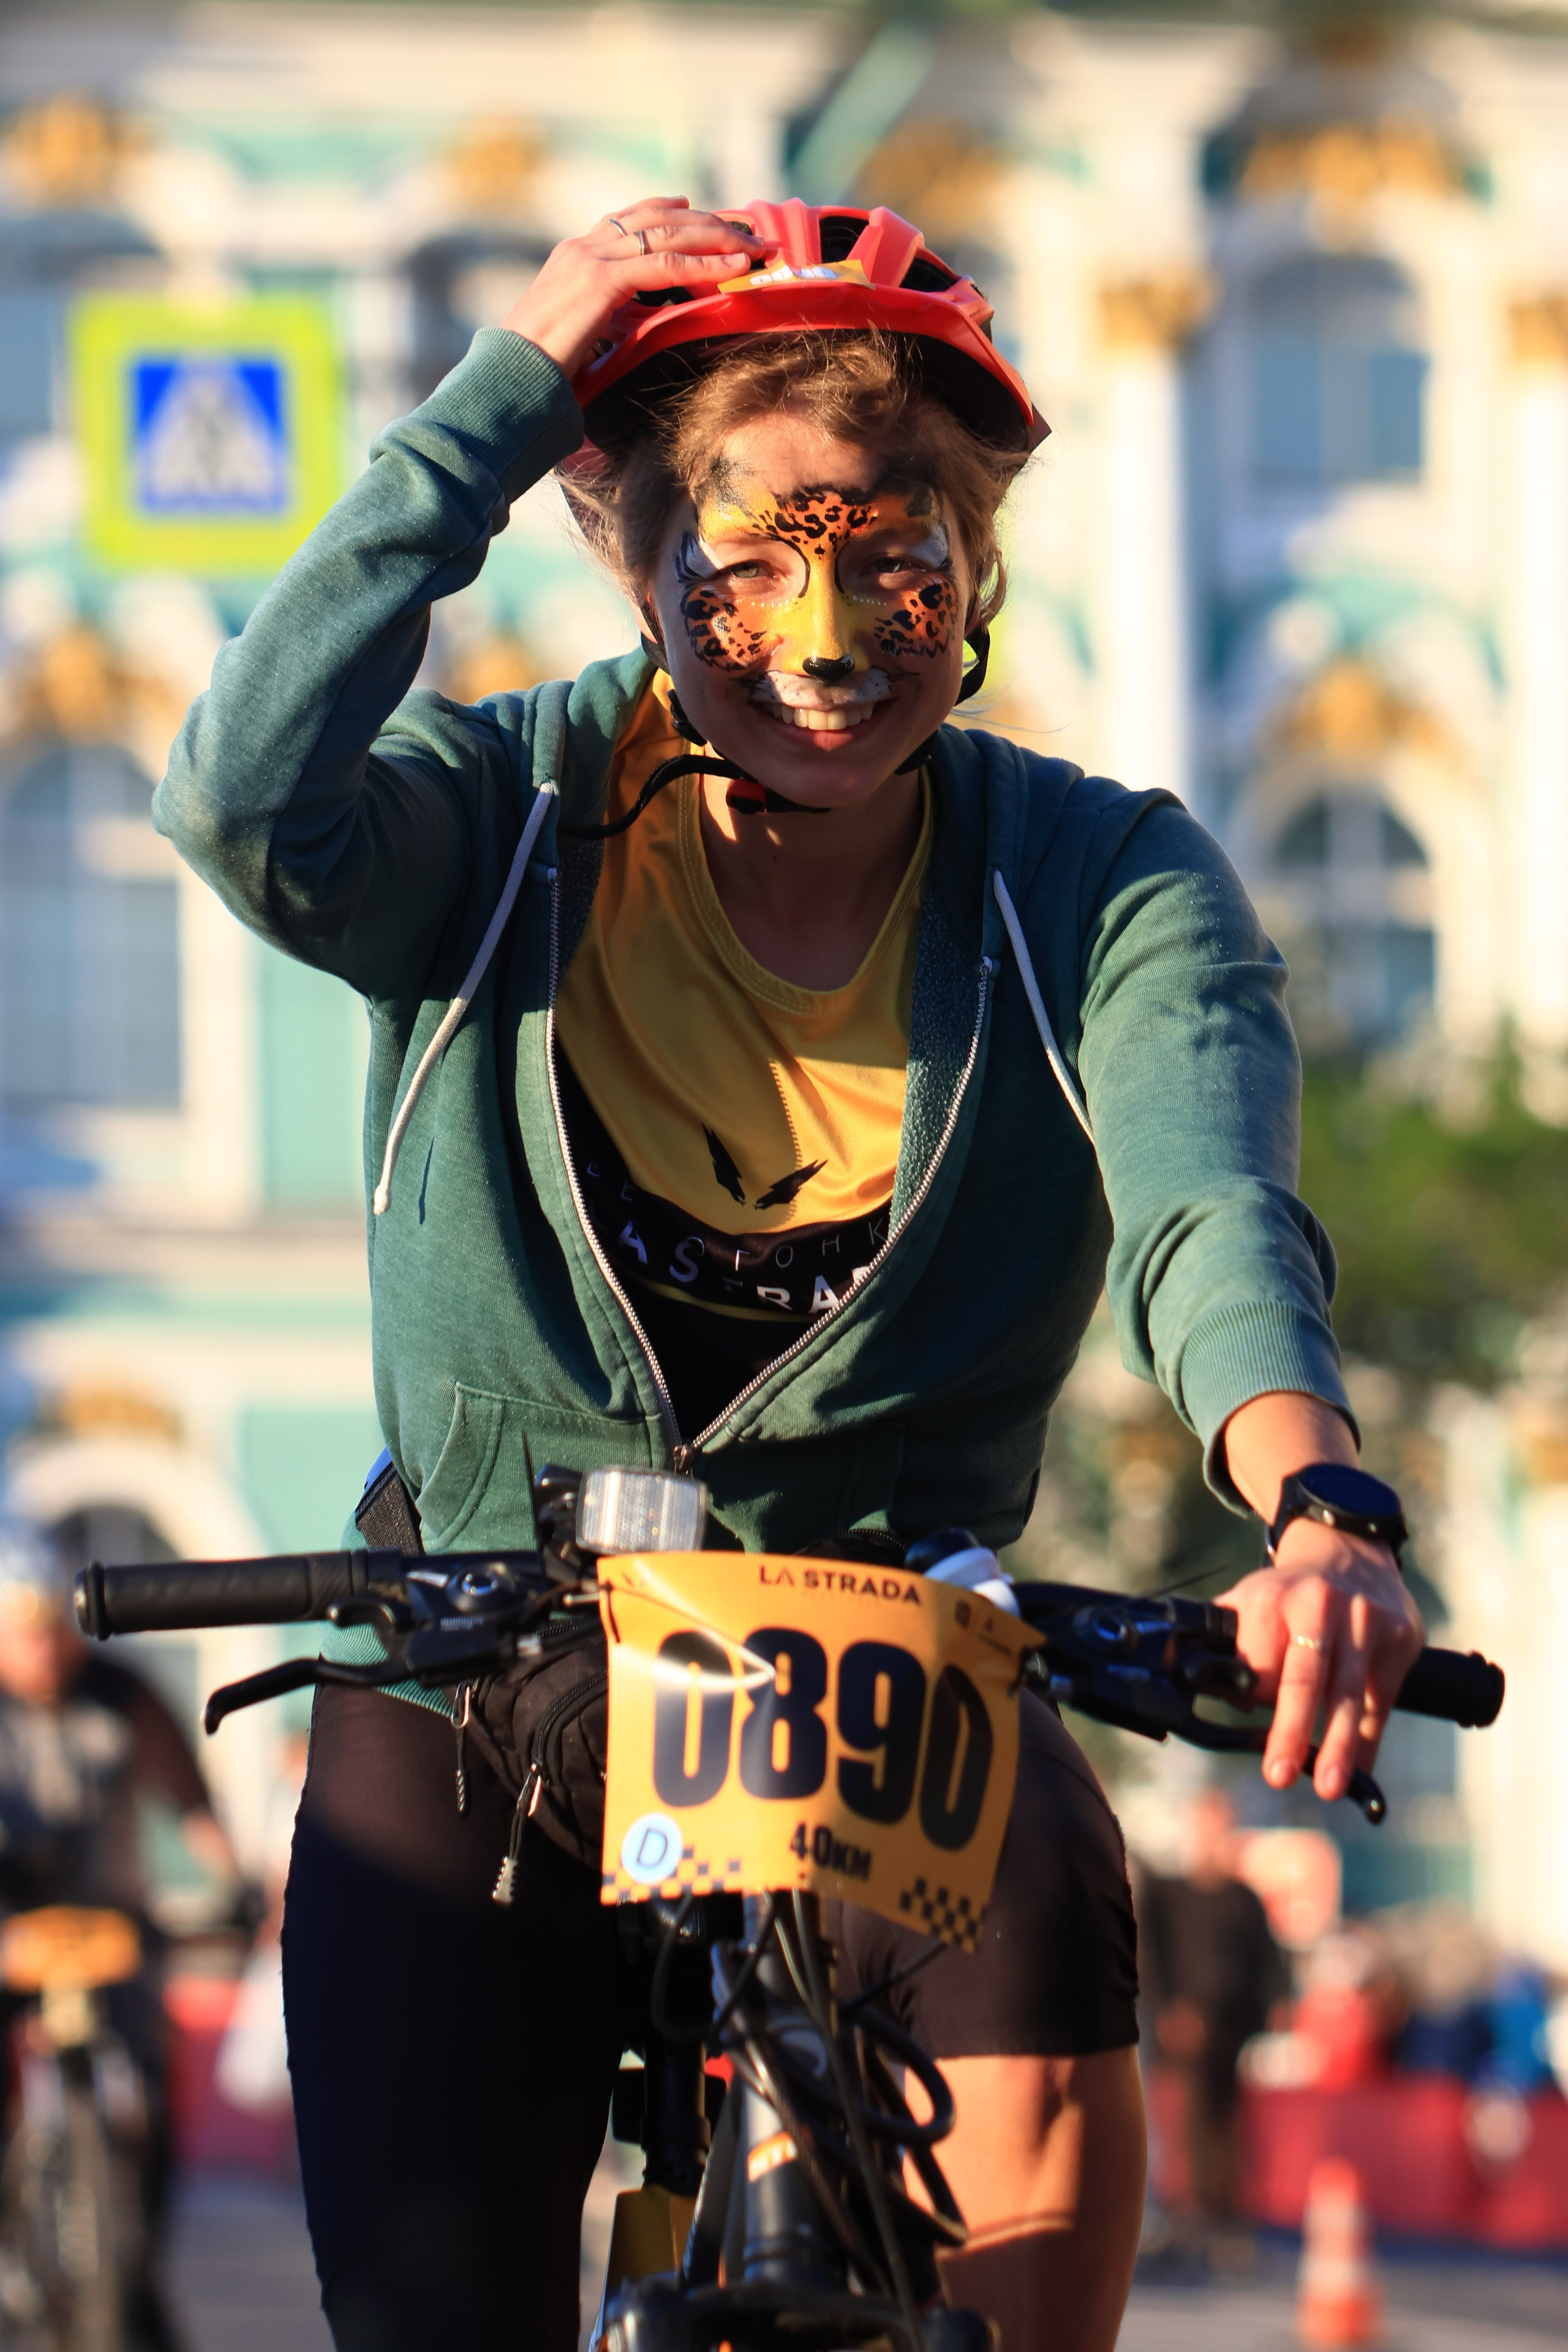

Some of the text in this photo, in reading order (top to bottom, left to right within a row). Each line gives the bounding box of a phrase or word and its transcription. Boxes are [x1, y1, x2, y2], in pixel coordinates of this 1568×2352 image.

[760, 1565, 794, 1586] LA
[804, 1570, 920, 1604] STRADA
[652, 1626, 993, 1850] 0890
[636, 1828, 669, 1869] D
